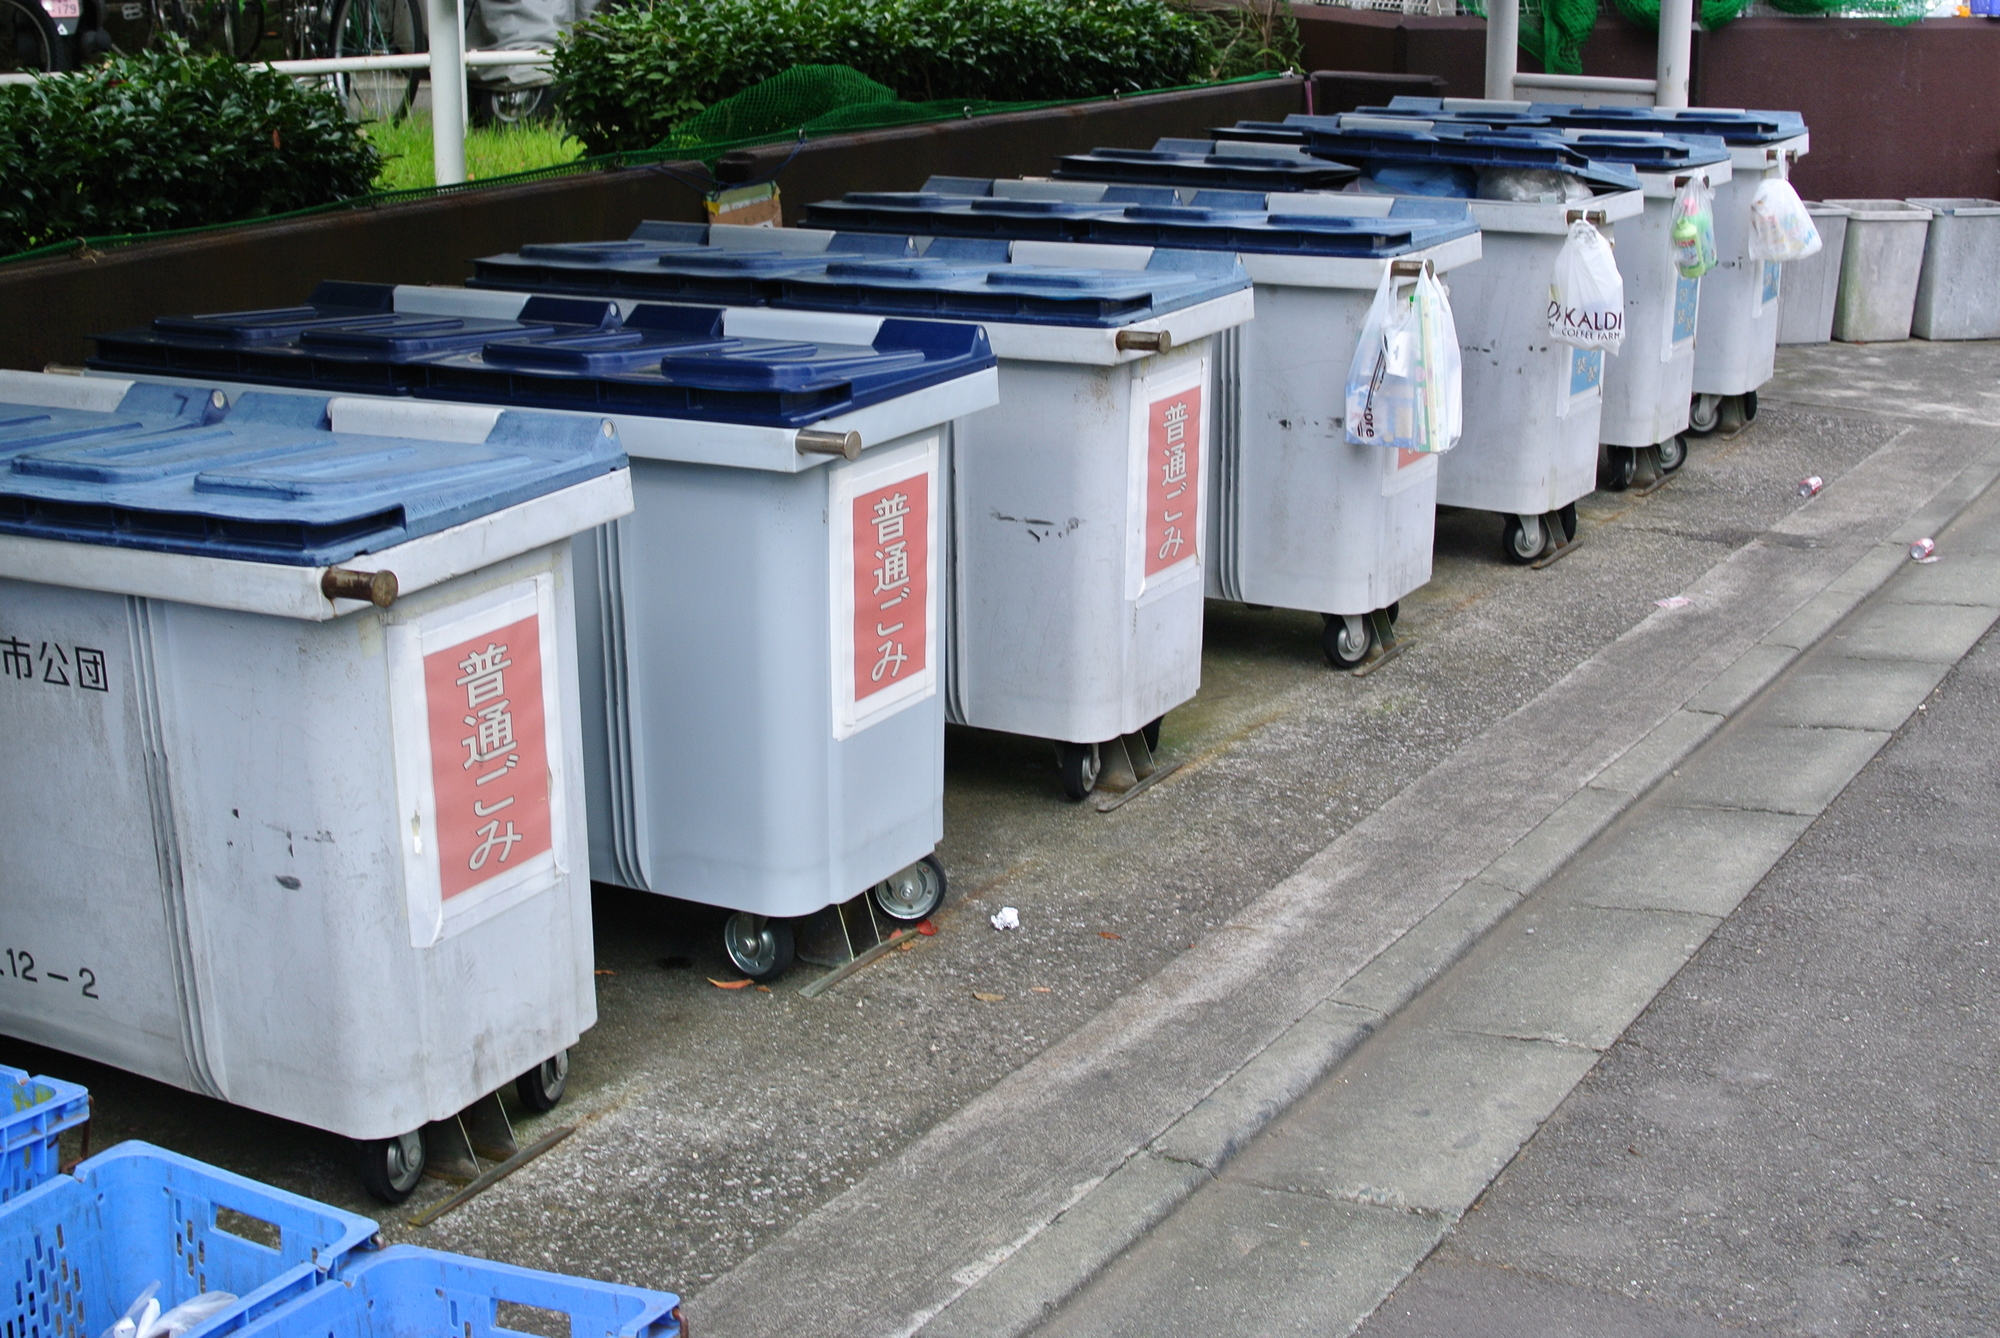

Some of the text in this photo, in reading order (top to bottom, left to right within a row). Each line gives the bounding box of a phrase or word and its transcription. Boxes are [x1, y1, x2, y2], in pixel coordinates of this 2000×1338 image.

[1561, 328, 1620, 341] COFFEE FARM
[1563, 306, 1622, 331] KALDI
[1158, 402, 1189, 560] 普通ごみ
[871, 492, 911, 682] 普通ごみ
[0, 636, 109, 692] 市公団
[456, 643, 523, 871] 普通ごみ
